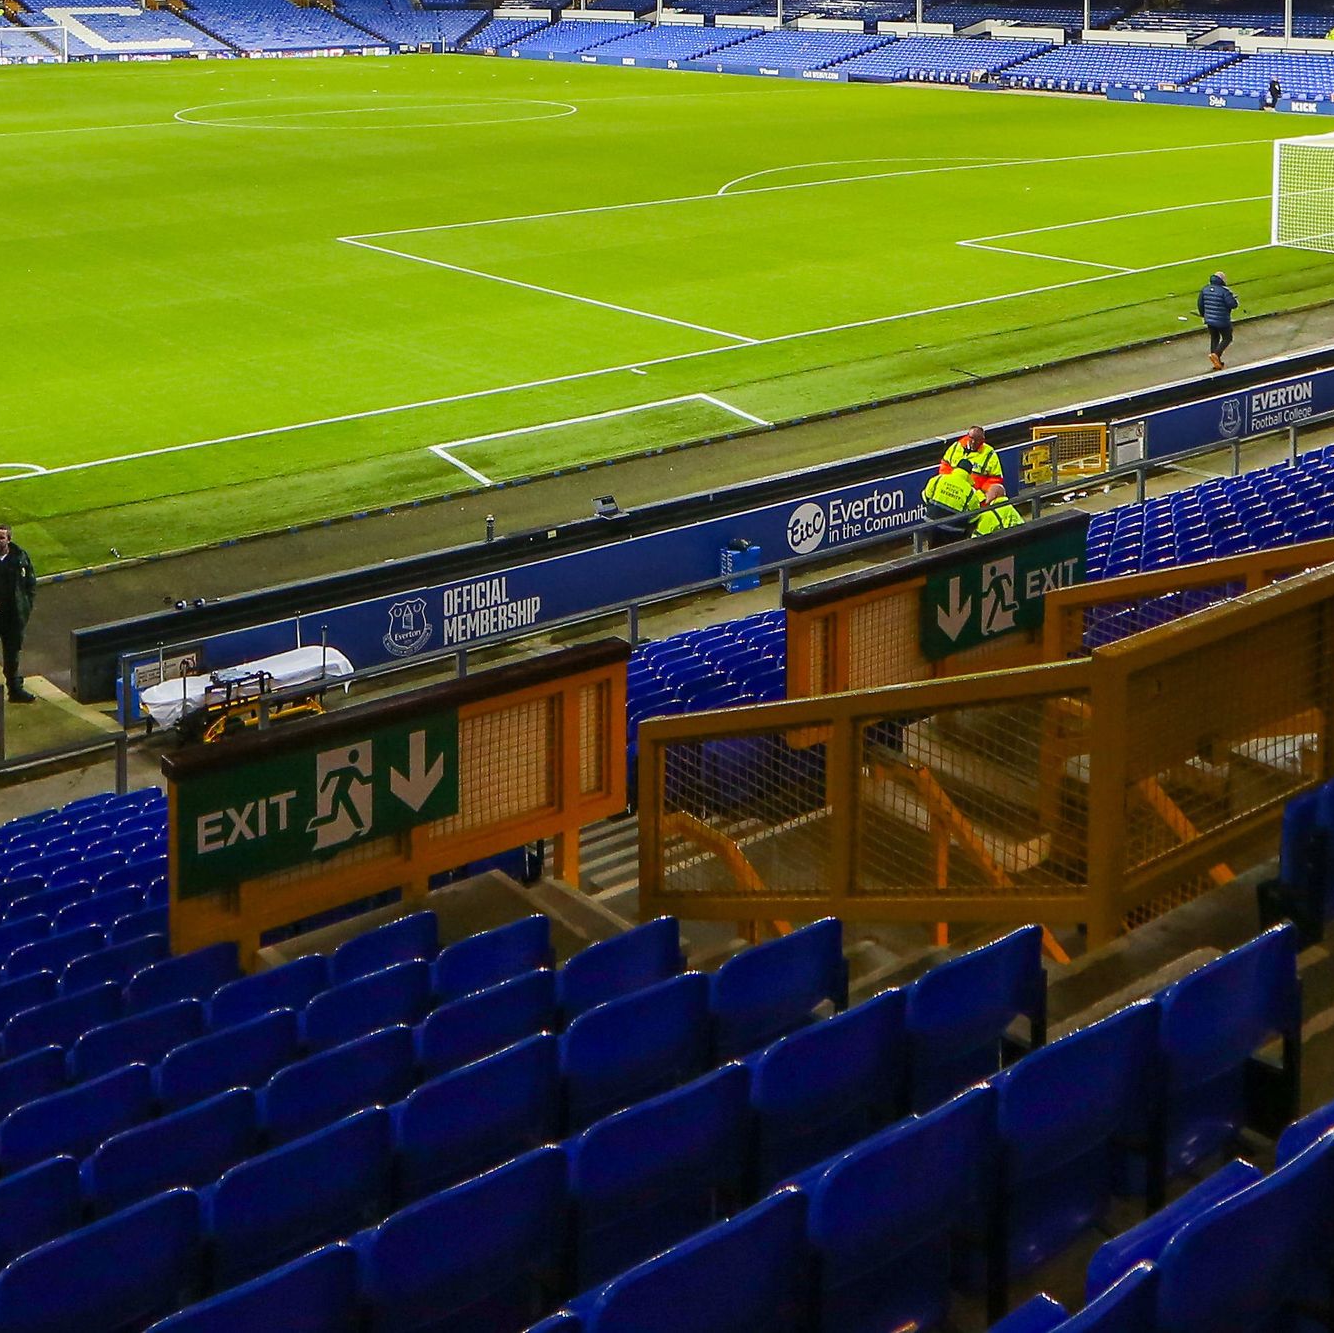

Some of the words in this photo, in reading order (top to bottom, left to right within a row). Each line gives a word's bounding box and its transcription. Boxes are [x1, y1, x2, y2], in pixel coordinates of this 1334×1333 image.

[1291, 101, 1317, 112] KICK
[1252, 381, 1312, 413] EVERTON
[1251, 411, 1283, 431] Football
[1283, 406, 1312, 423] College
[829, 489, 904, 526] Everton
[829, 527, 840, 543] in
[842, 523, 861, 538] the
[1026, 556, 1079, 597] EXIT
[443, 576, 509, 616] OFFICIAL
[394, 630, 421, 642] Everton
[443, 596, 541, 646] MEMBERSHIP
[197, 790, 298, 855] EXIT
